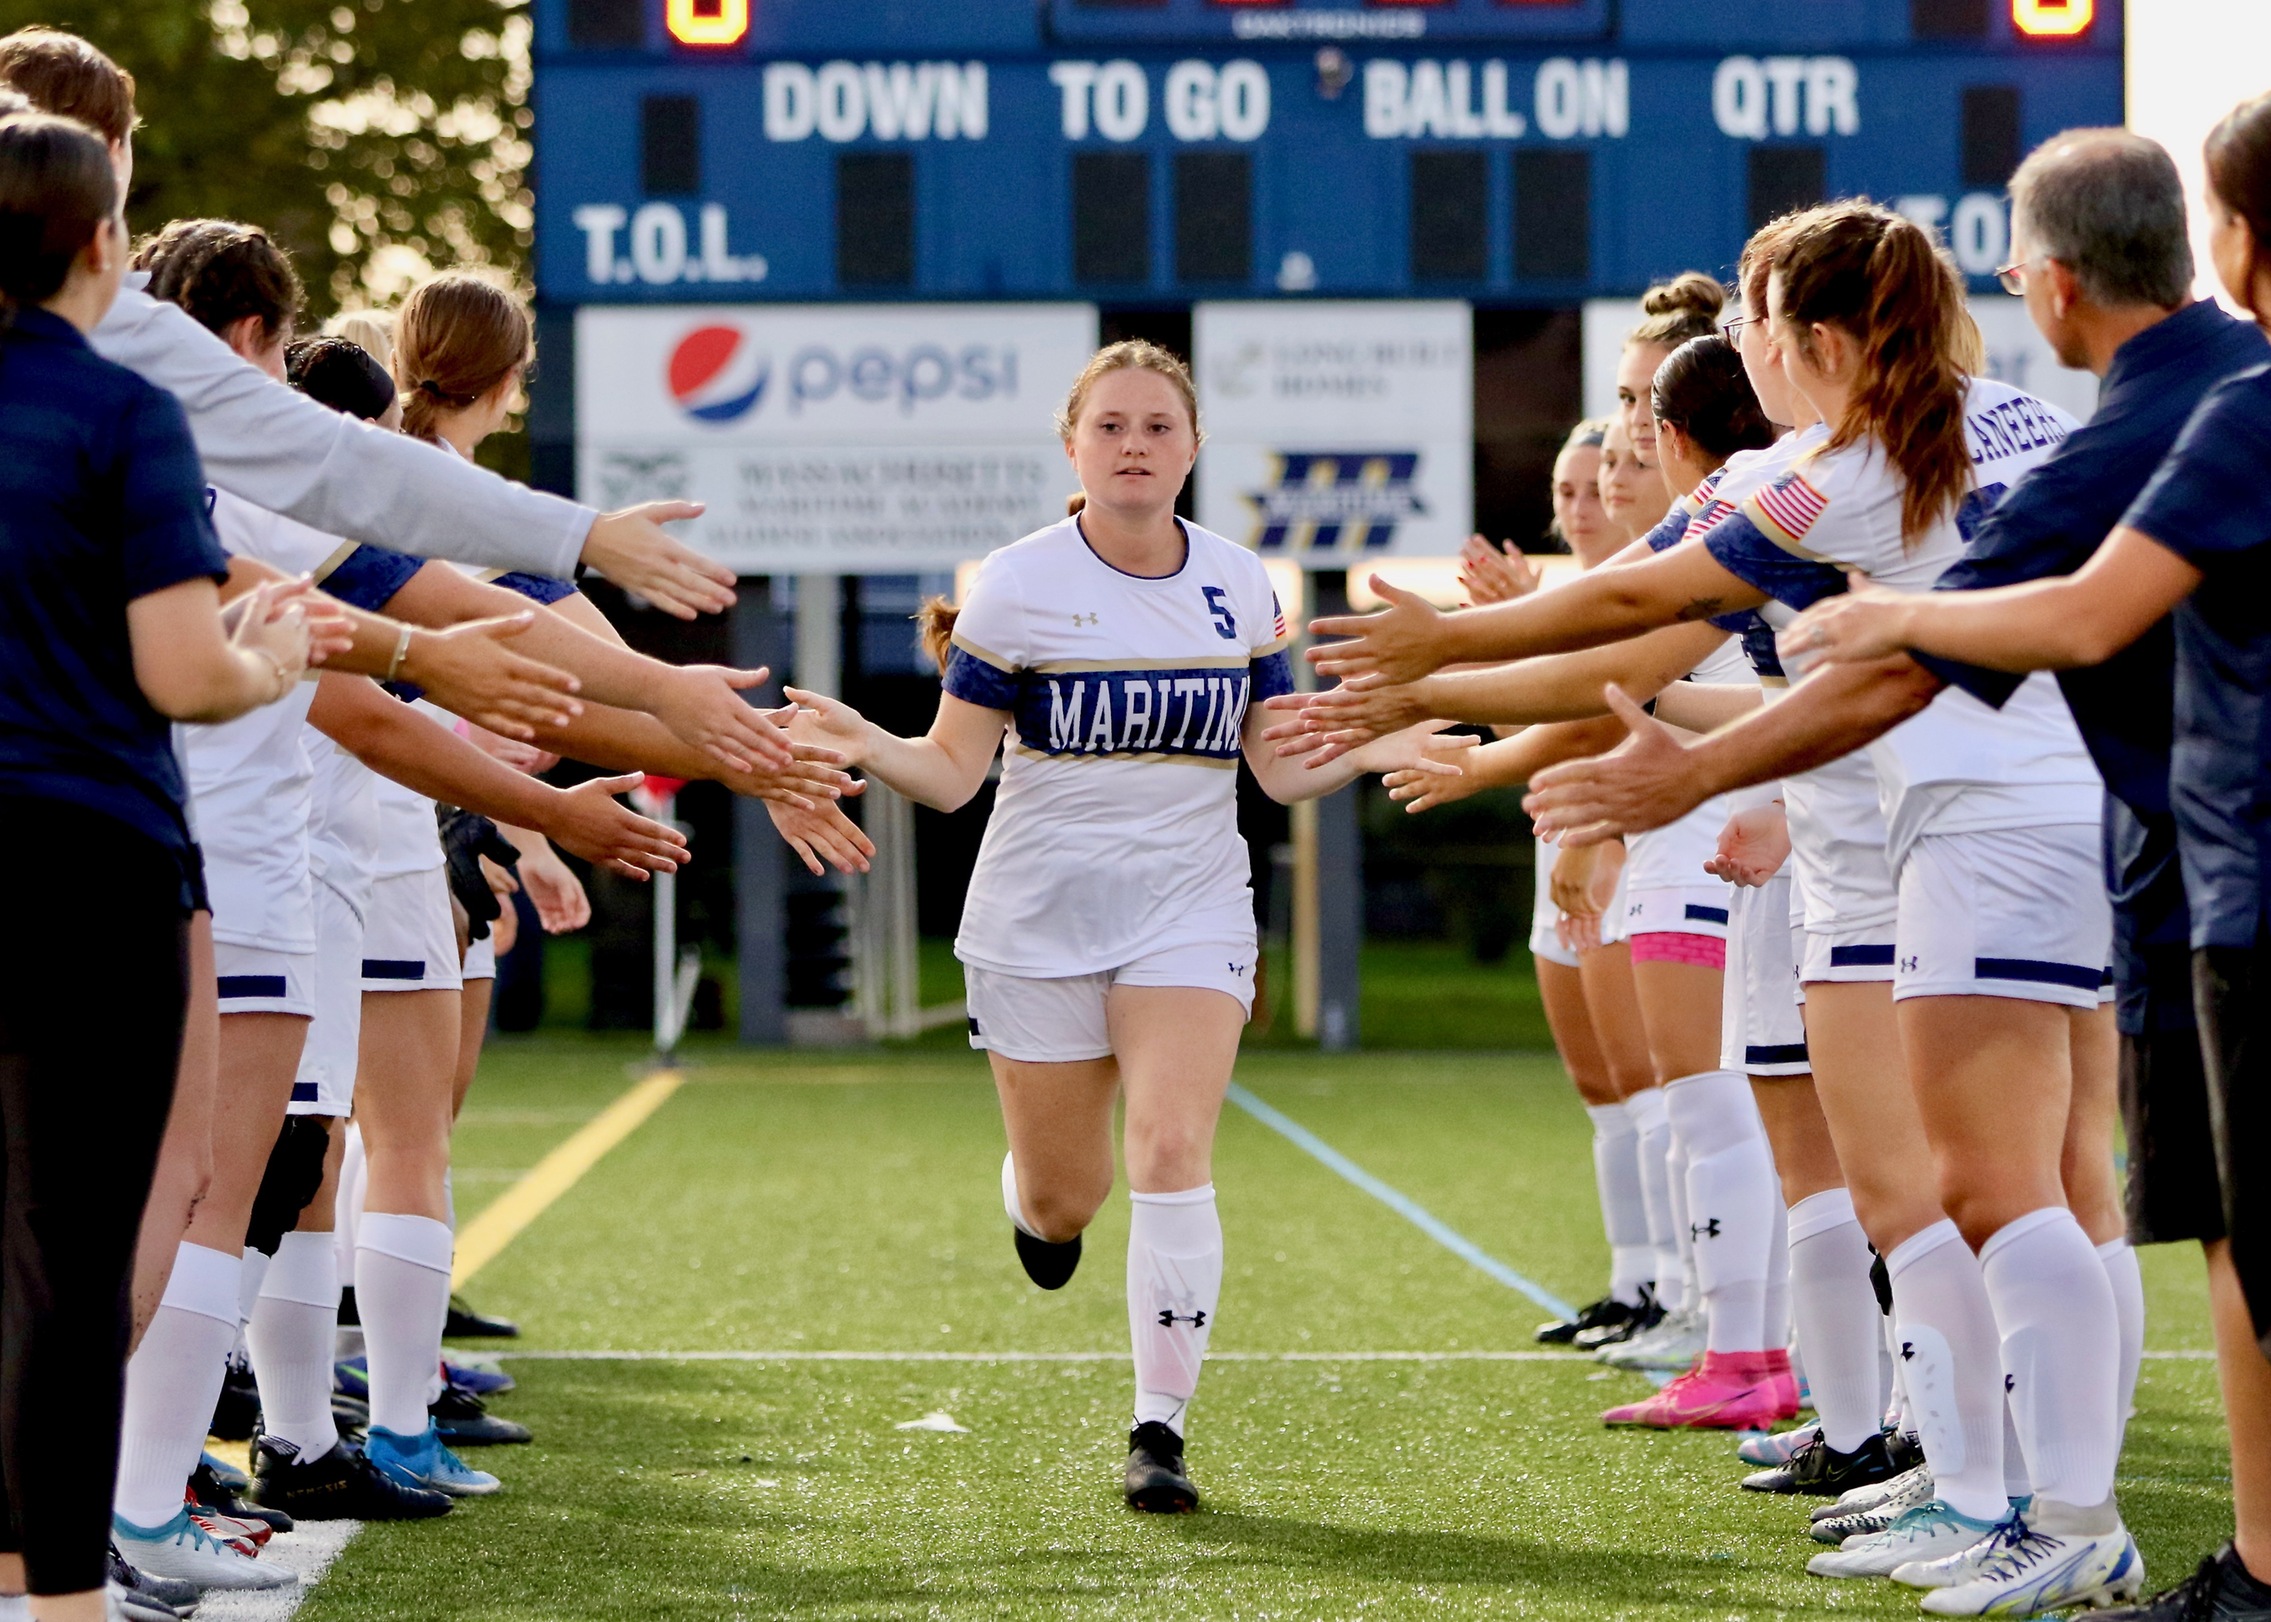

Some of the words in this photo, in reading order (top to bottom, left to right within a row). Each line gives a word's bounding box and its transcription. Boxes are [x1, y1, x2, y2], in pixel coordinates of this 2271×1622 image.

[762, 60, 989, 142] DOWN
[1050, 60, 1149, 142] TO
[1164, 60, 1271, 142] GO
[1364, 59, 1525, 140] BALL
[1535, 59, 1629, 139] ON
[1712, 56, 1859, 142] QTR
[573, 204, 767, 284] T.O.L.
[788, 344, 1019, 416] pepsi
[1201, 586, 1236, 639] 5
[1049, 675, 1251, 751] MARITIM
